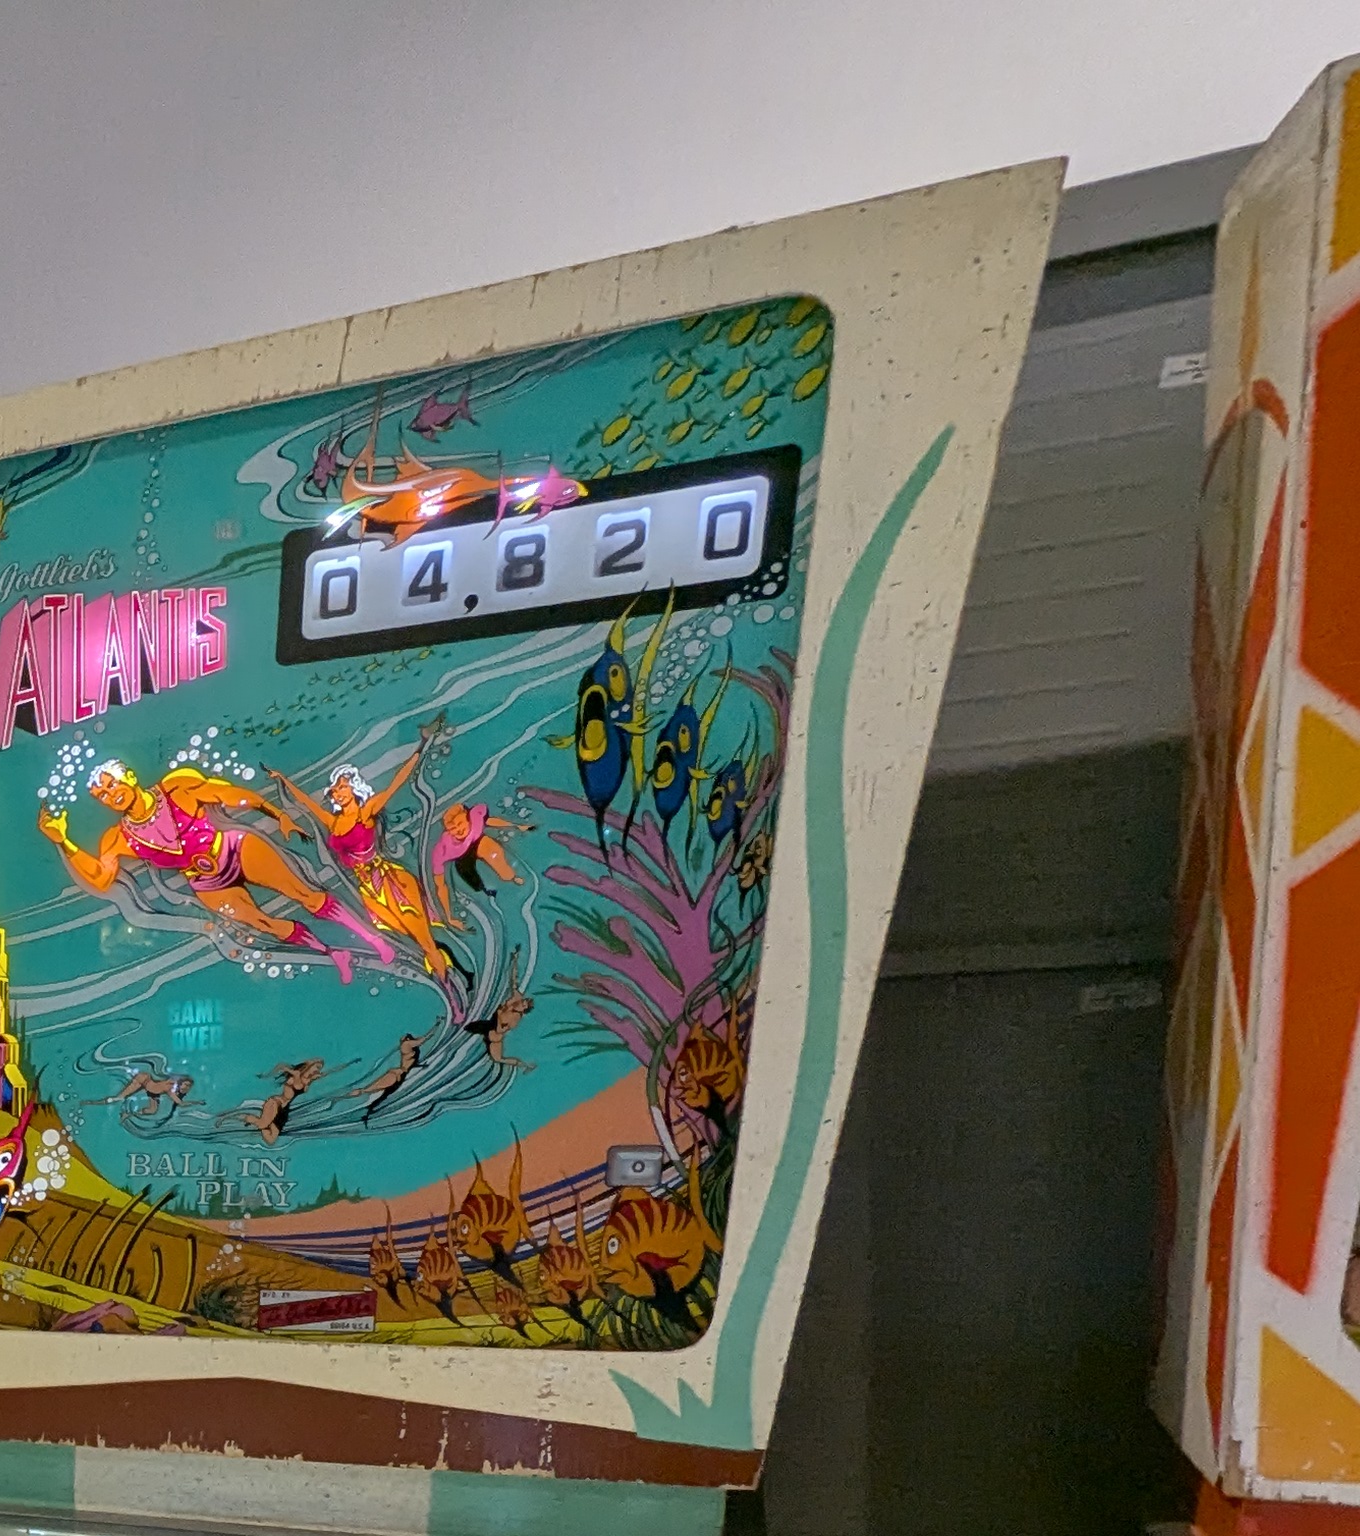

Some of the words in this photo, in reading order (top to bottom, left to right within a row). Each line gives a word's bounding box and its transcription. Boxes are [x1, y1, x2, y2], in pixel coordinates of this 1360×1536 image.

[168, 1000, 223, 1025] GAME
[172, 1026, 223, 1050] OVER
[126, 1152, 228, 1178] BALL
[238, 1156, 290, 1178] IN
[196, 1180, 298, 1208] PLAY
